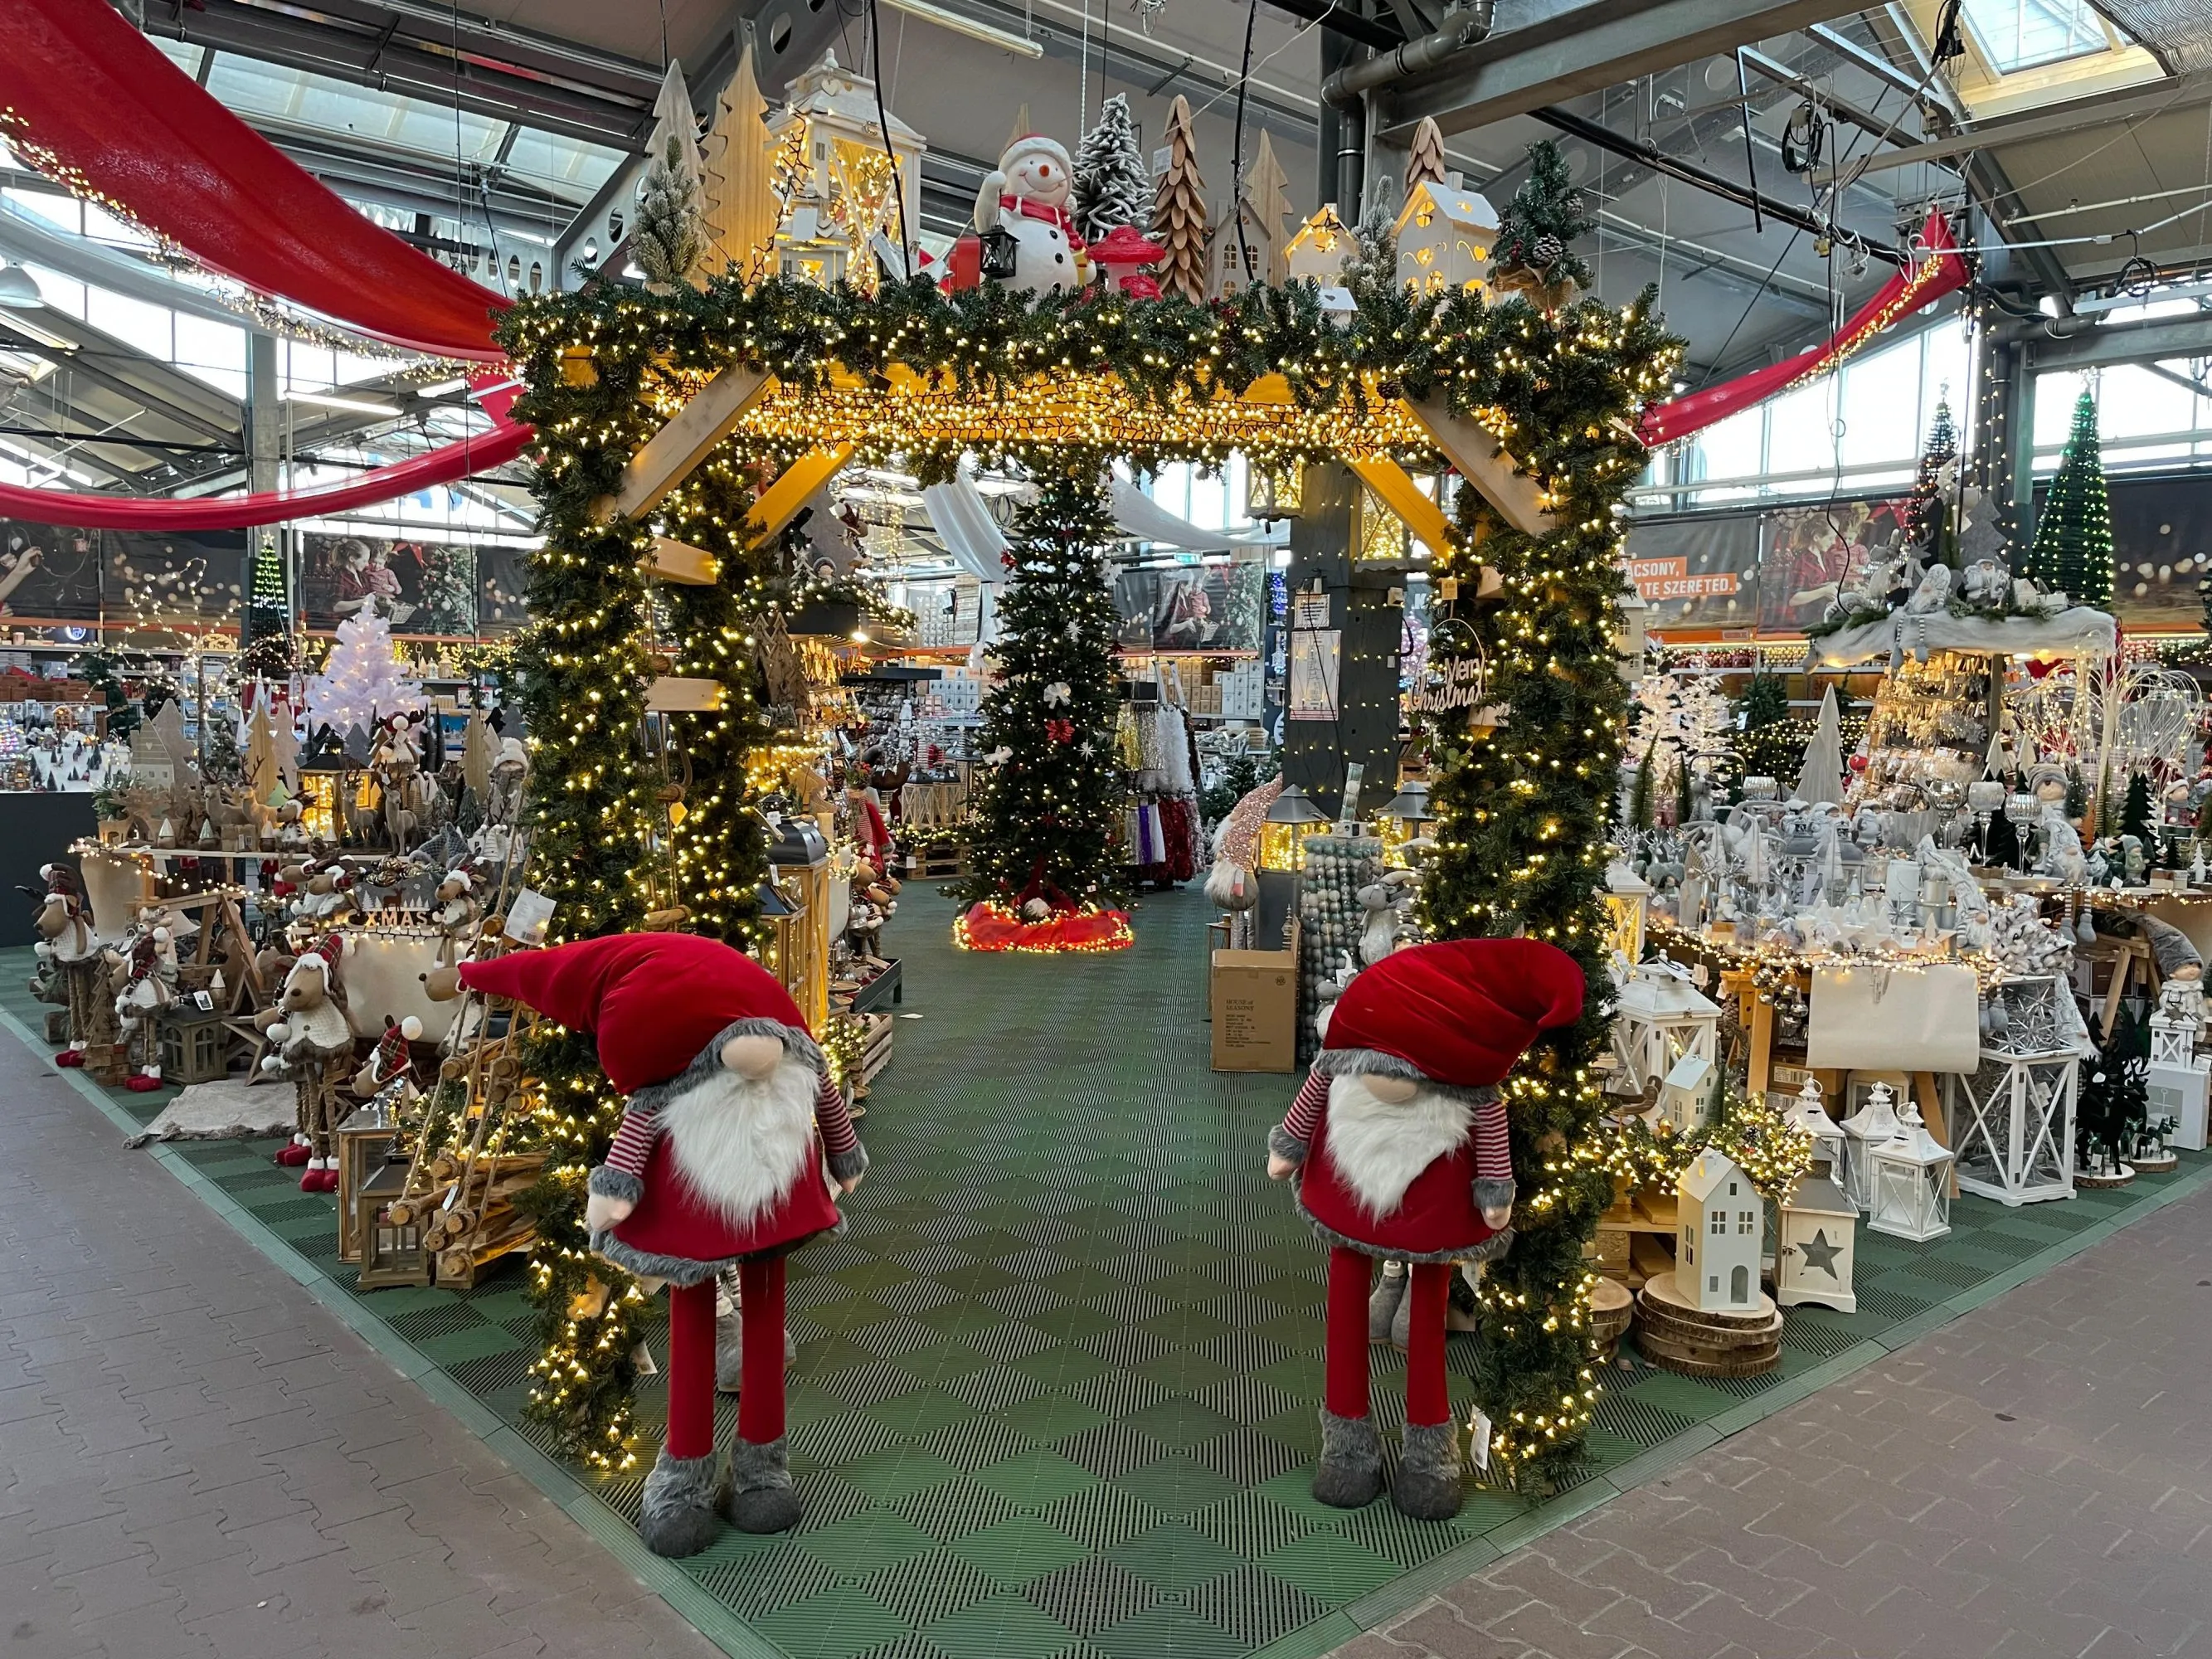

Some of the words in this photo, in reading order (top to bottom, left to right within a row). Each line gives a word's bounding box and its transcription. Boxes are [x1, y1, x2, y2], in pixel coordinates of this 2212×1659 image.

[1645, 581, 1660, 596] TE
[1663, 577, 1733, 596] SZERETED.
[1444, 655, 1482, 683] Merry
[1410, 674, 1483, 712] Christmas
[366, 911, 427, 927] XMAS
